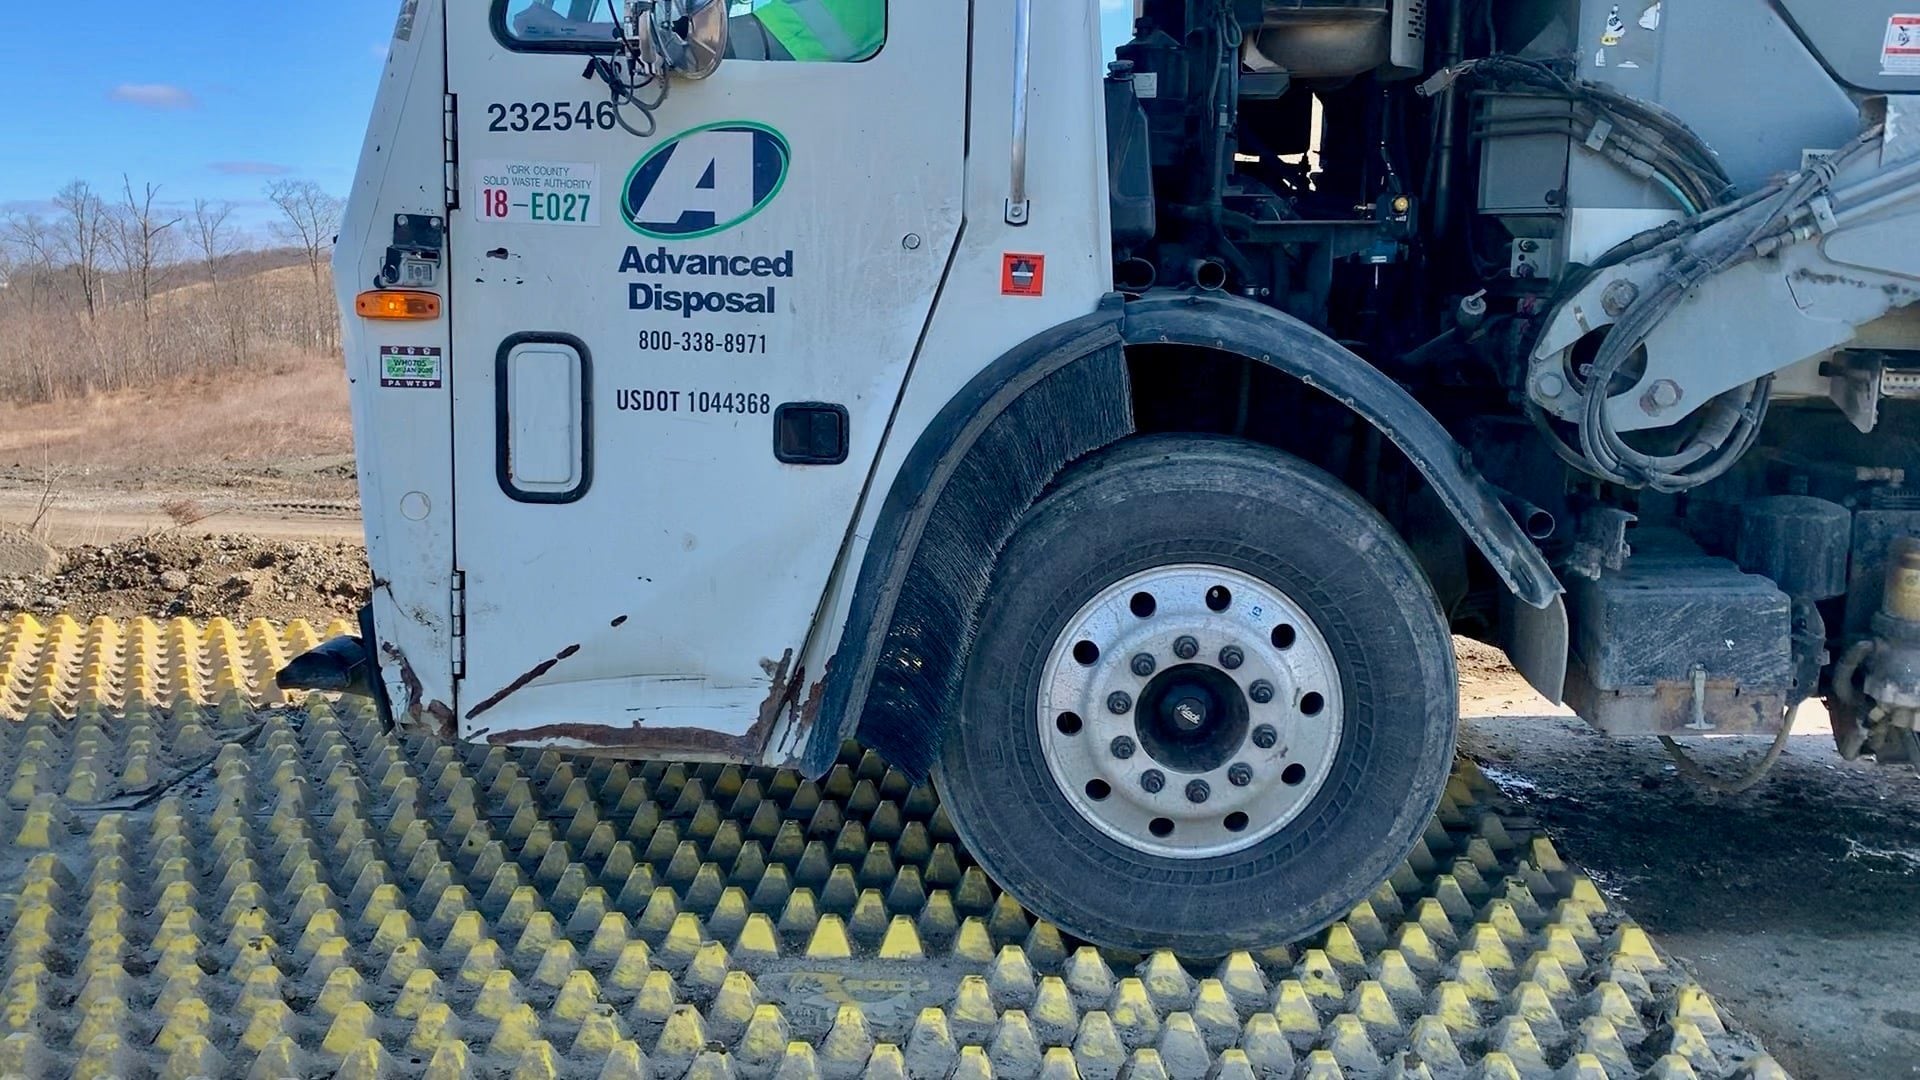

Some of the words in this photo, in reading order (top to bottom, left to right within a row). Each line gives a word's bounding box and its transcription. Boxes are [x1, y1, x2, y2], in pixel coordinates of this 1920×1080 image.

[488, 101, 616, 132] 232546
[483, 176, 509, 187] SOLID
[511, 177, 540, 188] WASTE
[543, 178, 592, 189] AUTHORITY
[506, 164, 530, 175] YORK
[533, 166, 569, 177] COUNTY
[618, 246, 793, 277] Advanced
[628, 282, 775, 318] Disposal
[638, 330, 767, 354] 800-338-8971
[616, 389, 680, 412] USDOT
[688, 391, 770, 414] 1044368
